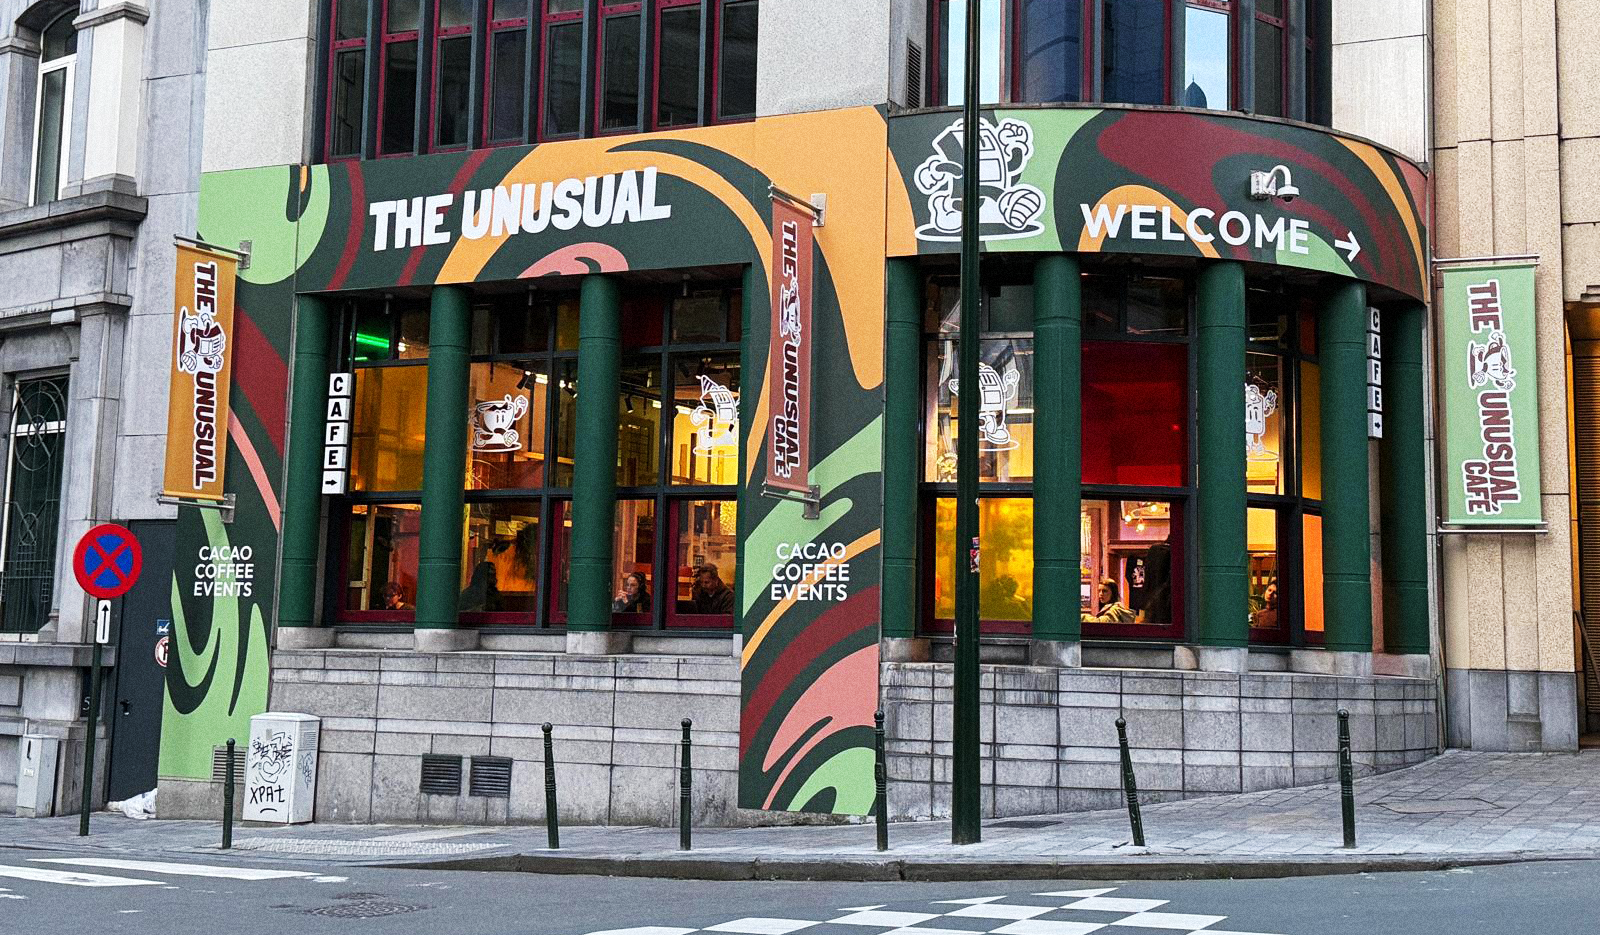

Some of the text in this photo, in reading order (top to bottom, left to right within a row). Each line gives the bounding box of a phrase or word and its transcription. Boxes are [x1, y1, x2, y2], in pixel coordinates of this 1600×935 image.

[369, 166, 672, 251] THE UNUSUAL
[1080, 203, 1309, 255] WELCOME
[783, 222, 800, 469] THE UNUSUAL
[1371, 311, 1382, 408] CAFE
[195, 263, 215, 487] THE UNUSUAL
[1469, 281, 1519, 504] THE UNUSUAL
[328, 376, 344, 466] CAFE
[195, 563, 254, 579] COFFEE
[199, 545, 253, 561] CACAO
[772, 563, 850, 581] COFFEE
[776, 542, 847, 560] CACAO
[193, 582, 253, 597] EVENTS
[770, 583, 848, 602] EVENTS
